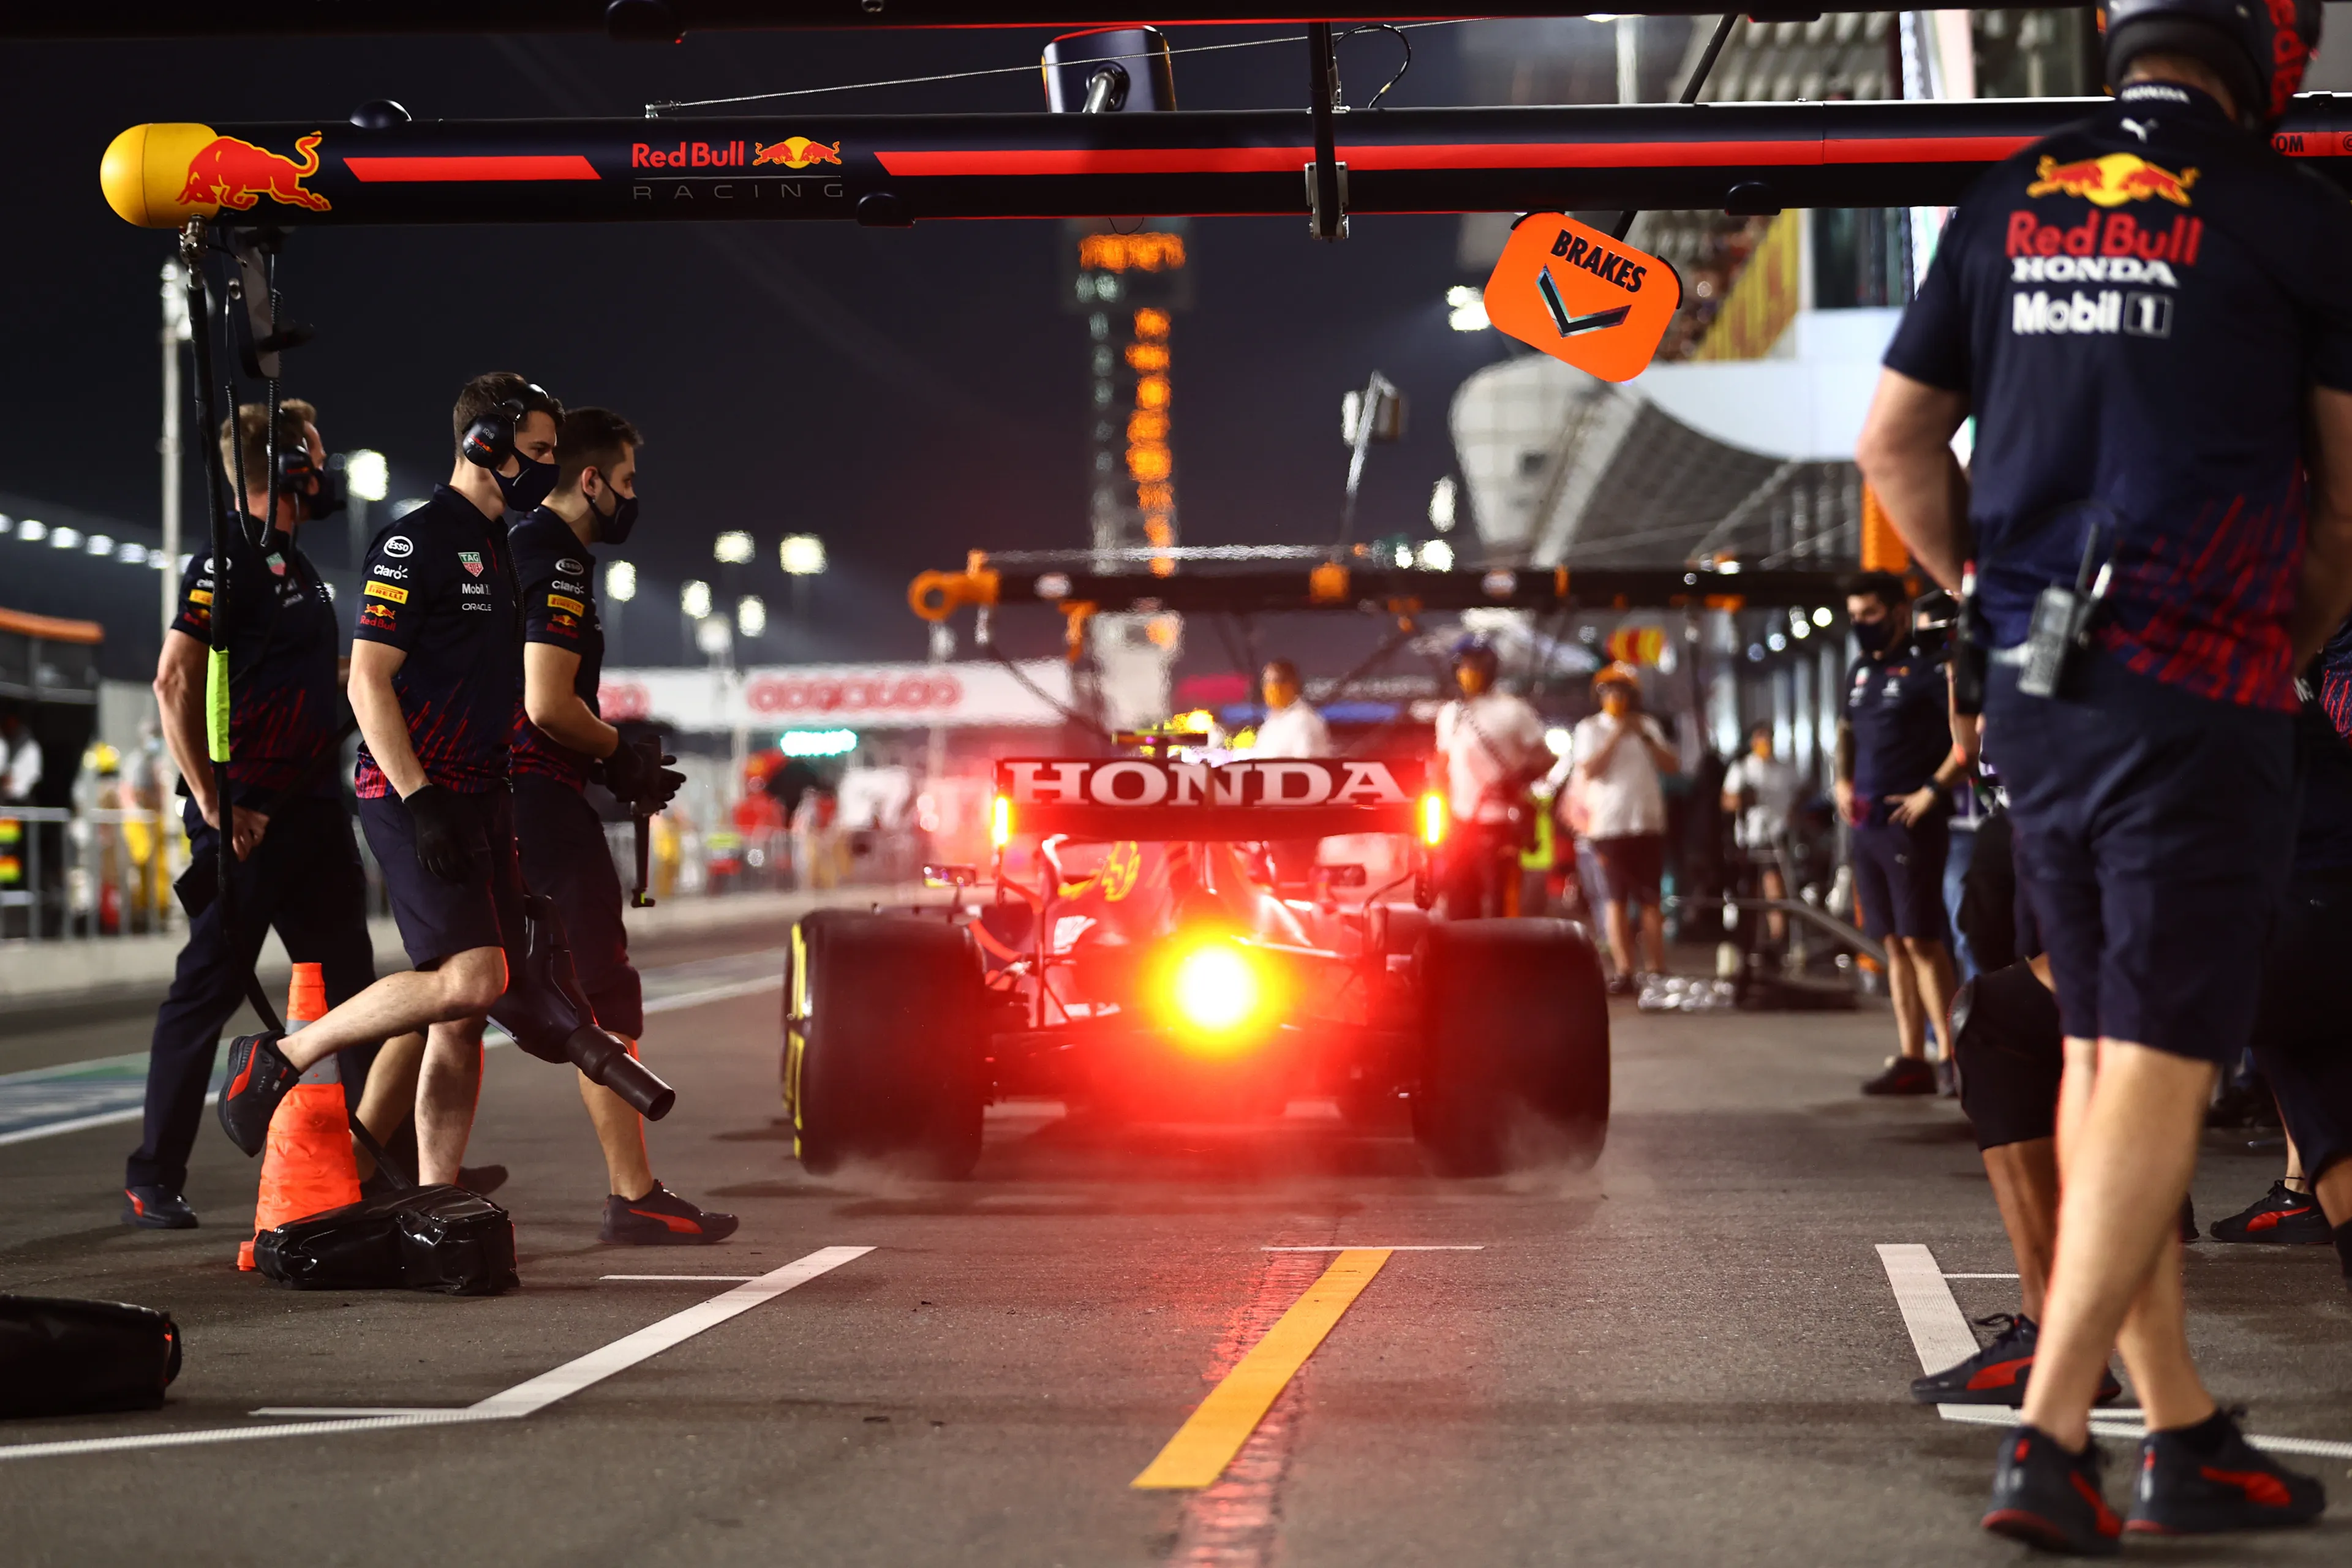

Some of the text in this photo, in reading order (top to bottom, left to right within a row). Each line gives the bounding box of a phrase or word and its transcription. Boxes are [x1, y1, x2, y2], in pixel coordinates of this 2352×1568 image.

[2271, 135, 2304, 153] OM
[632, 140, 745, 168] Red Bull
[633, 183, 843, 200] RACING
[2005, 208, 2204, 266] Red Bull
[1550, 228, 1648, 293] BRAKES
[2011, 255, 2180, 288] HONDA
[2012, 290, 2122, 335] Mobil
[374, 564, 402, 579] Claro
[369, 584, 404, 600] PIRELLI
[462, 584, 484, 595] Mobil
[551, 580, 581, 595] Claro
[462, 603, 492, 611] ORACLE
[360, 615, 397, 632] Red Bull
[1006, 761, 1413, 807] HONDA
